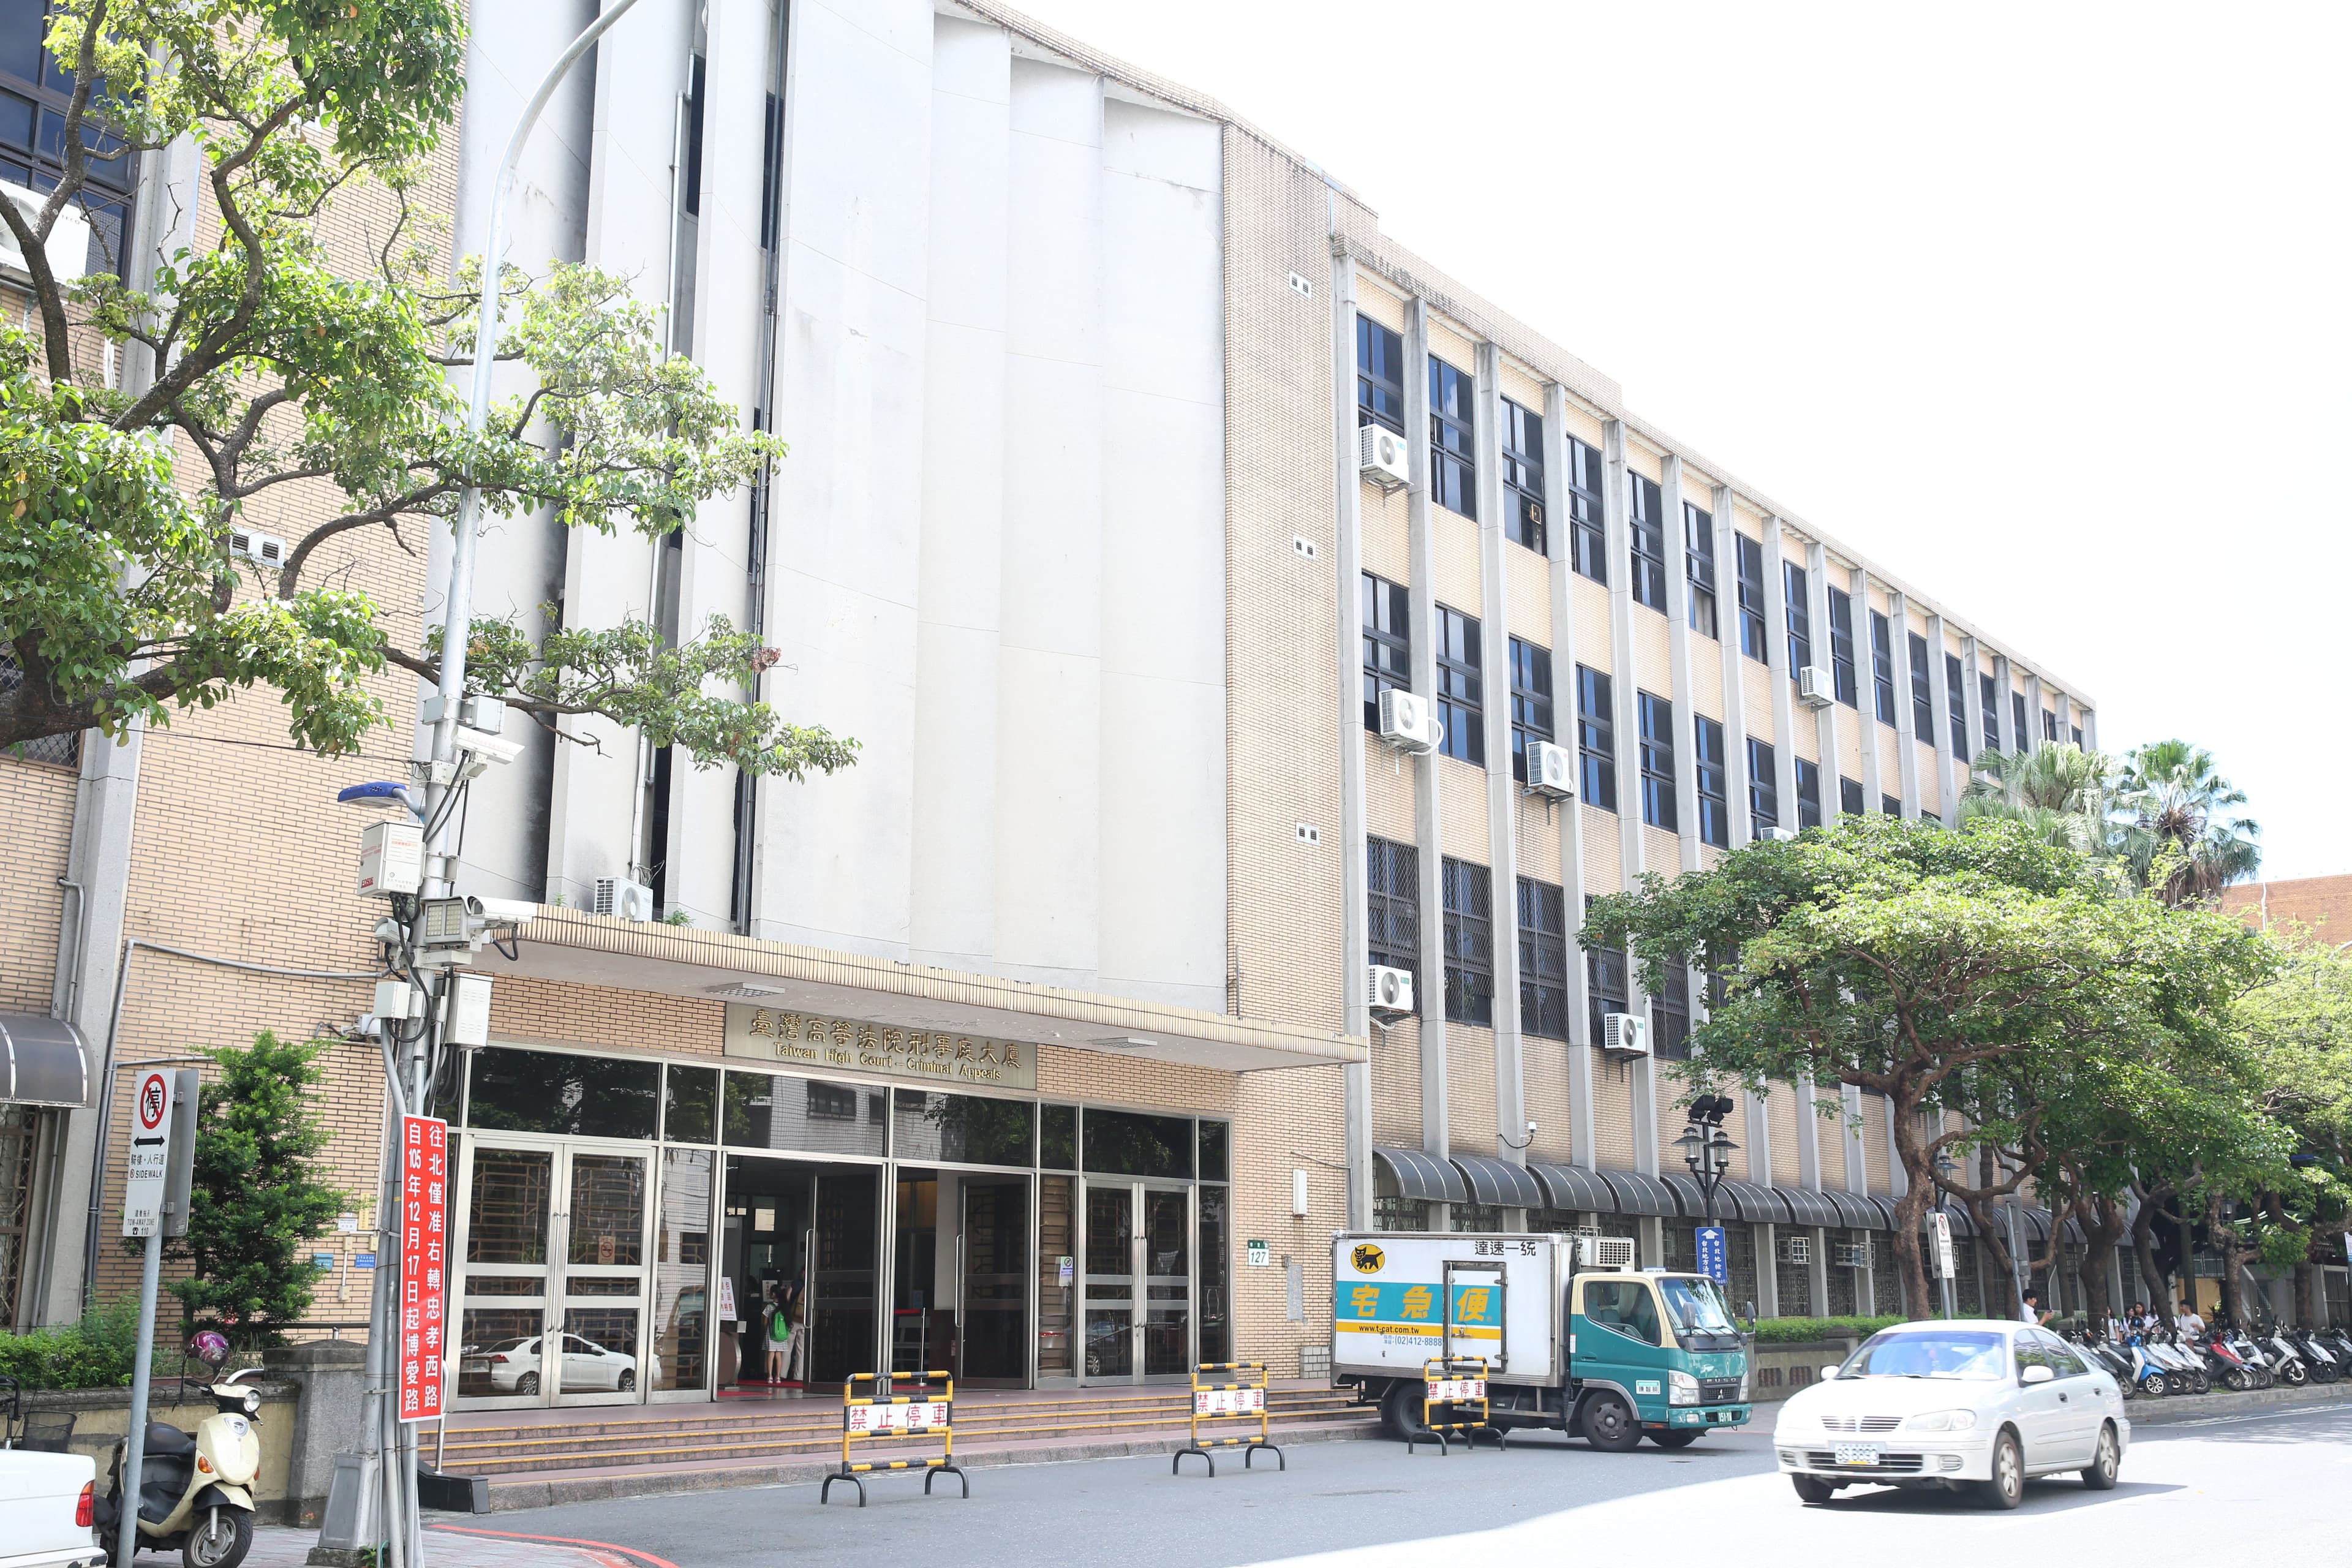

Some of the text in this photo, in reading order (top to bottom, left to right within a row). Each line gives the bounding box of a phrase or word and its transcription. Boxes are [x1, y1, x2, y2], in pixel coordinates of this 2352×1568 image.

[750, 1009, 1022, 1068] 臺灣高等法院刑事庭大廈
[774, 1042, 818, 1059] Taiwan
[824, 1048, 853, 1065] High
[860, 1052, 892, 1067] Court
[907, 1057, 952, 1074] Criminal
[960, 1065, 1001, 1080] Appeals
[135, 1169, 163, 1178] SIDEWALK
[405, 1122, 421, 1412] 自105年12月17日起博愛路
[424, 1125, 443, 1408] 往北僅准右轉忠孝西路
[1251, 1251, 1266, 1263] 127
[1701, 1240, 1710, 1276] 台北地方法
[1350, 1284, 1490, 1322] 宅急便
[1359, 1324, 1420, 1334] www.t-cat.com.tw
[1197, 1389, 1263, 1412] 禁止停車
[1428, 1380, 1483, 1399] 禁止停車
[851, 1403, 946, 1430] 禁止停車
